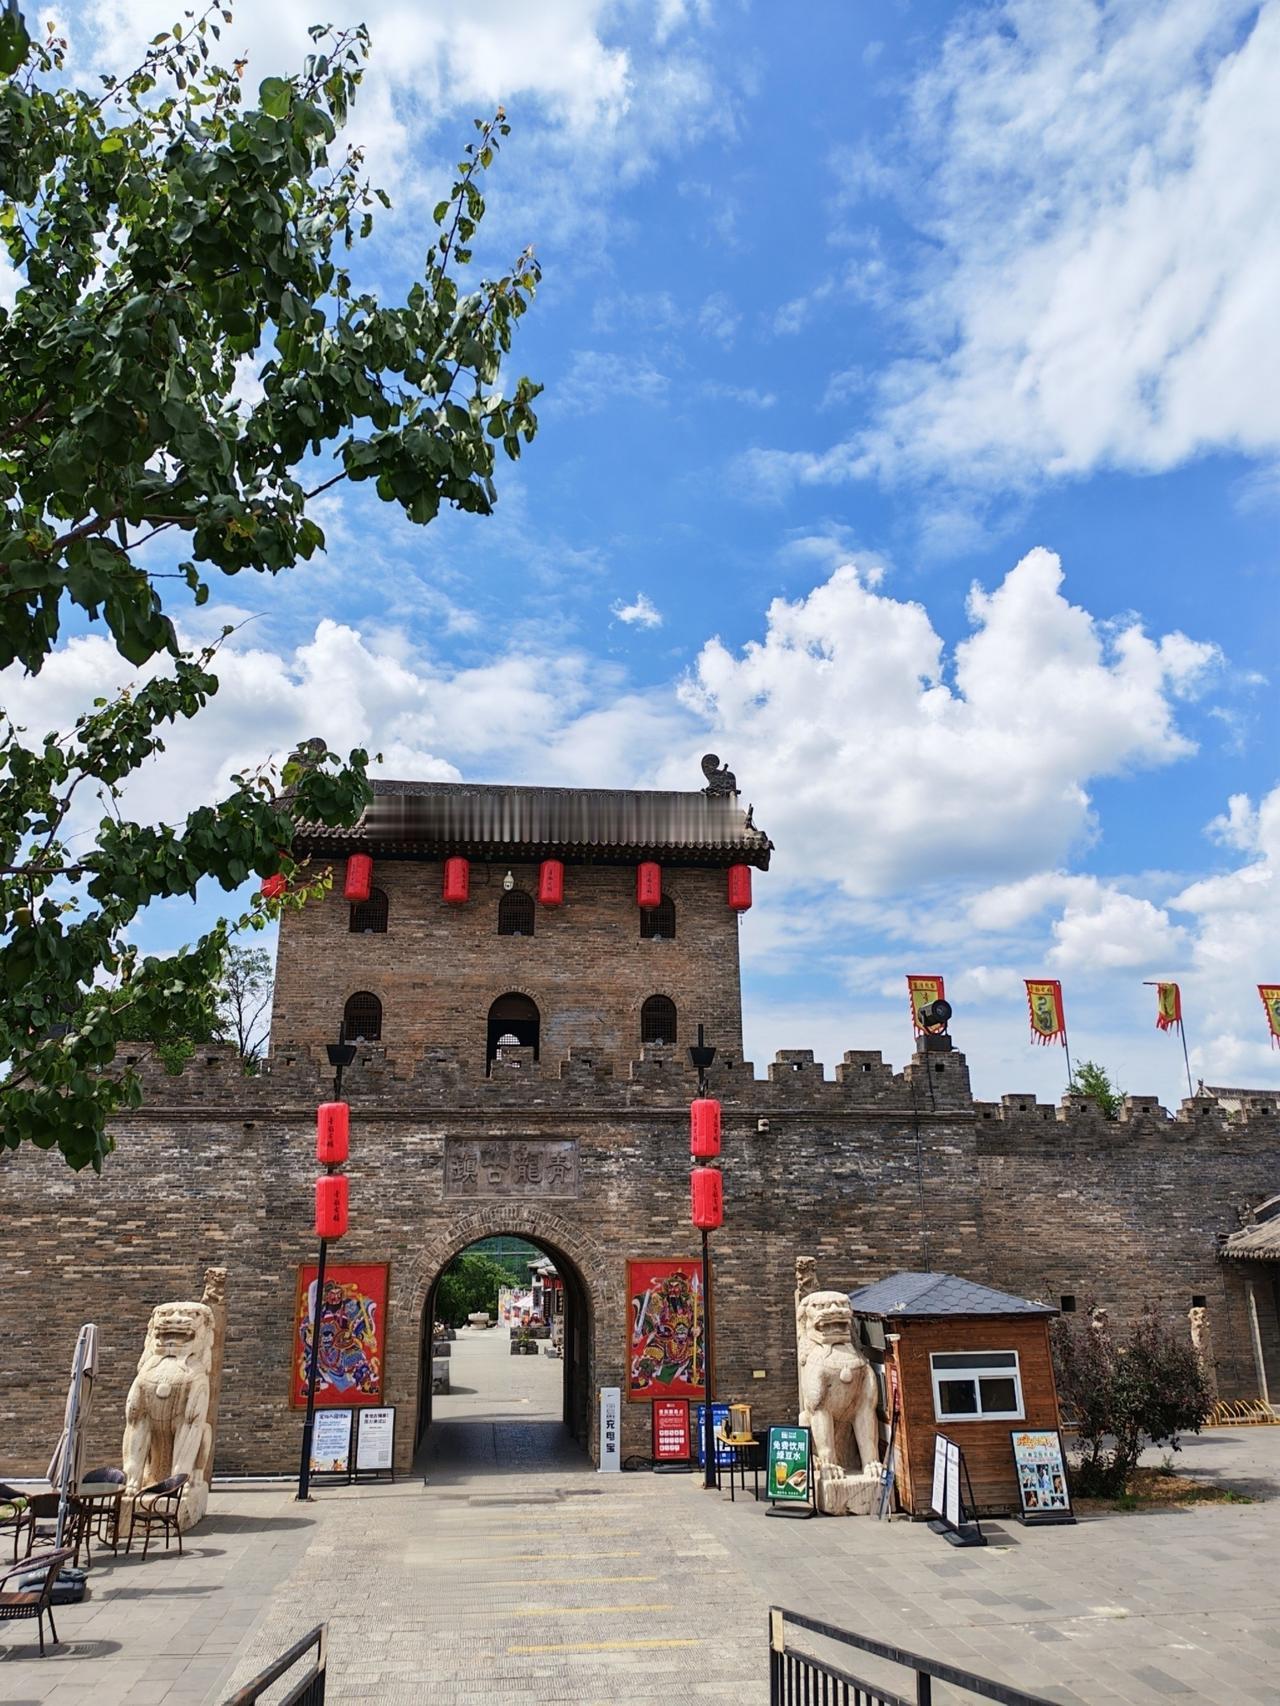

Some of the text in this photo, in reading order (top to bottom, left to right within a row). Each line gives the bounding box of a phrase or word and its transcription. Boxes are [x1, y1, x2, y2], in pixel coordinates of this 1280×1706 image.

[606, 1420, 616, 1453] 充电宝
[773, 1440, 805, 1452] 免费饮用
[776, 1450, 801, 1461] 绿豆水
